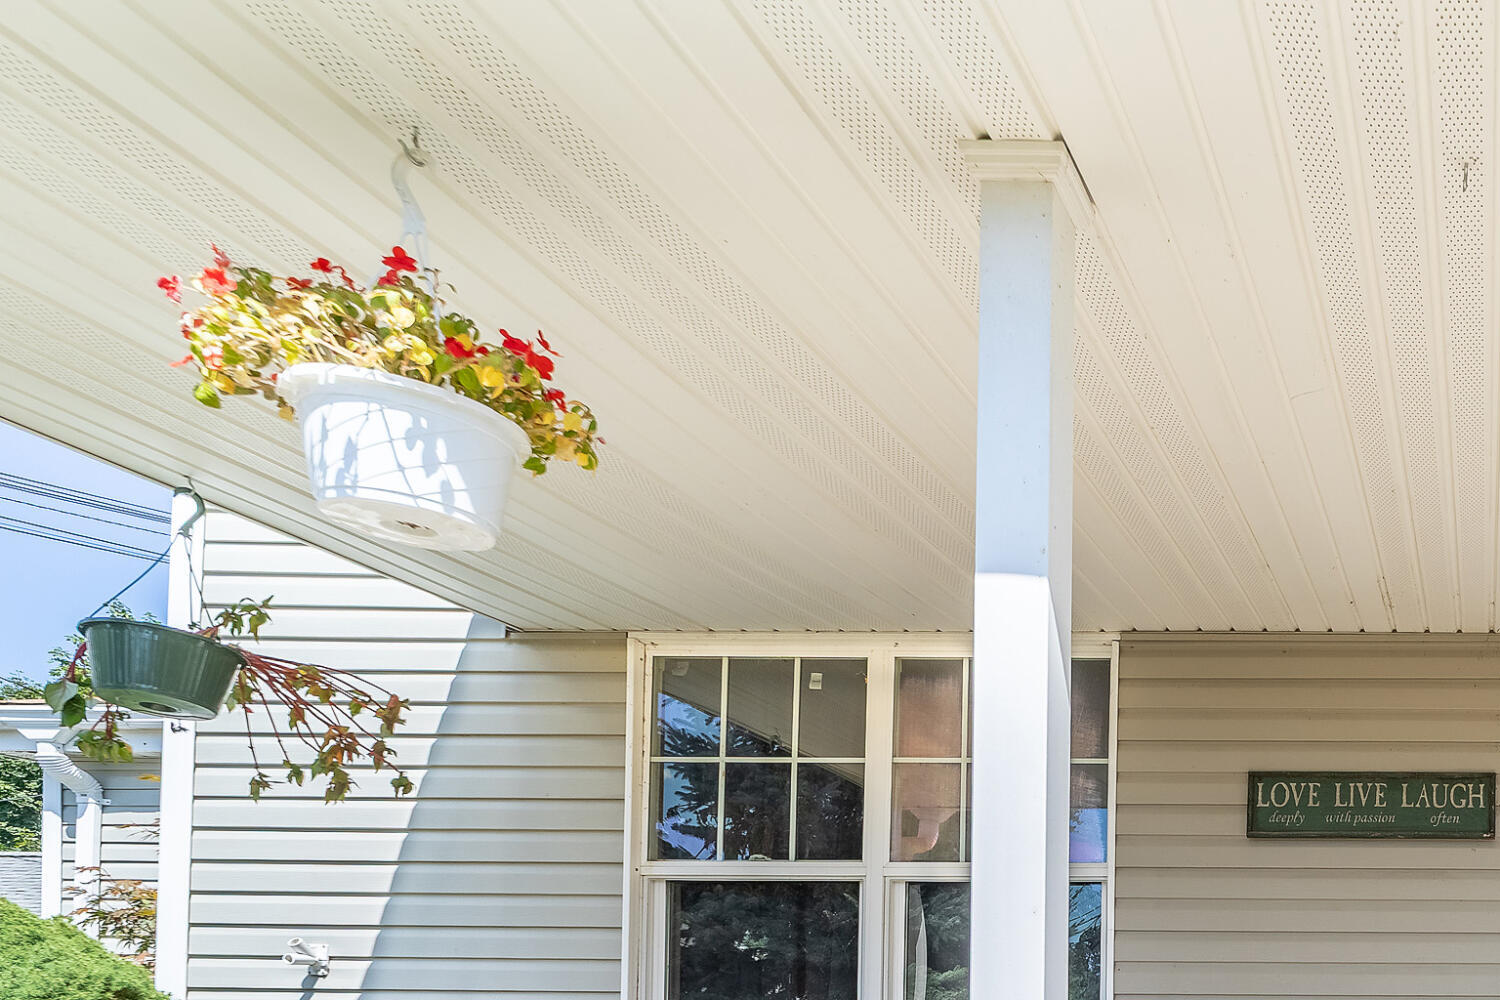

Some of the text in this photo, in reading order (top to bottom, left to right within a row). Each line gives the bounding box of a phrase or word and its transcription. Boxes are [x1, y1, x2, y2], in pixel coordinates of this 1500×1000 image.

[1256, 782, 1486, 809] LOVE LIVE LAUGH
[1268, 810, 1461, 827] deeply with passion often
